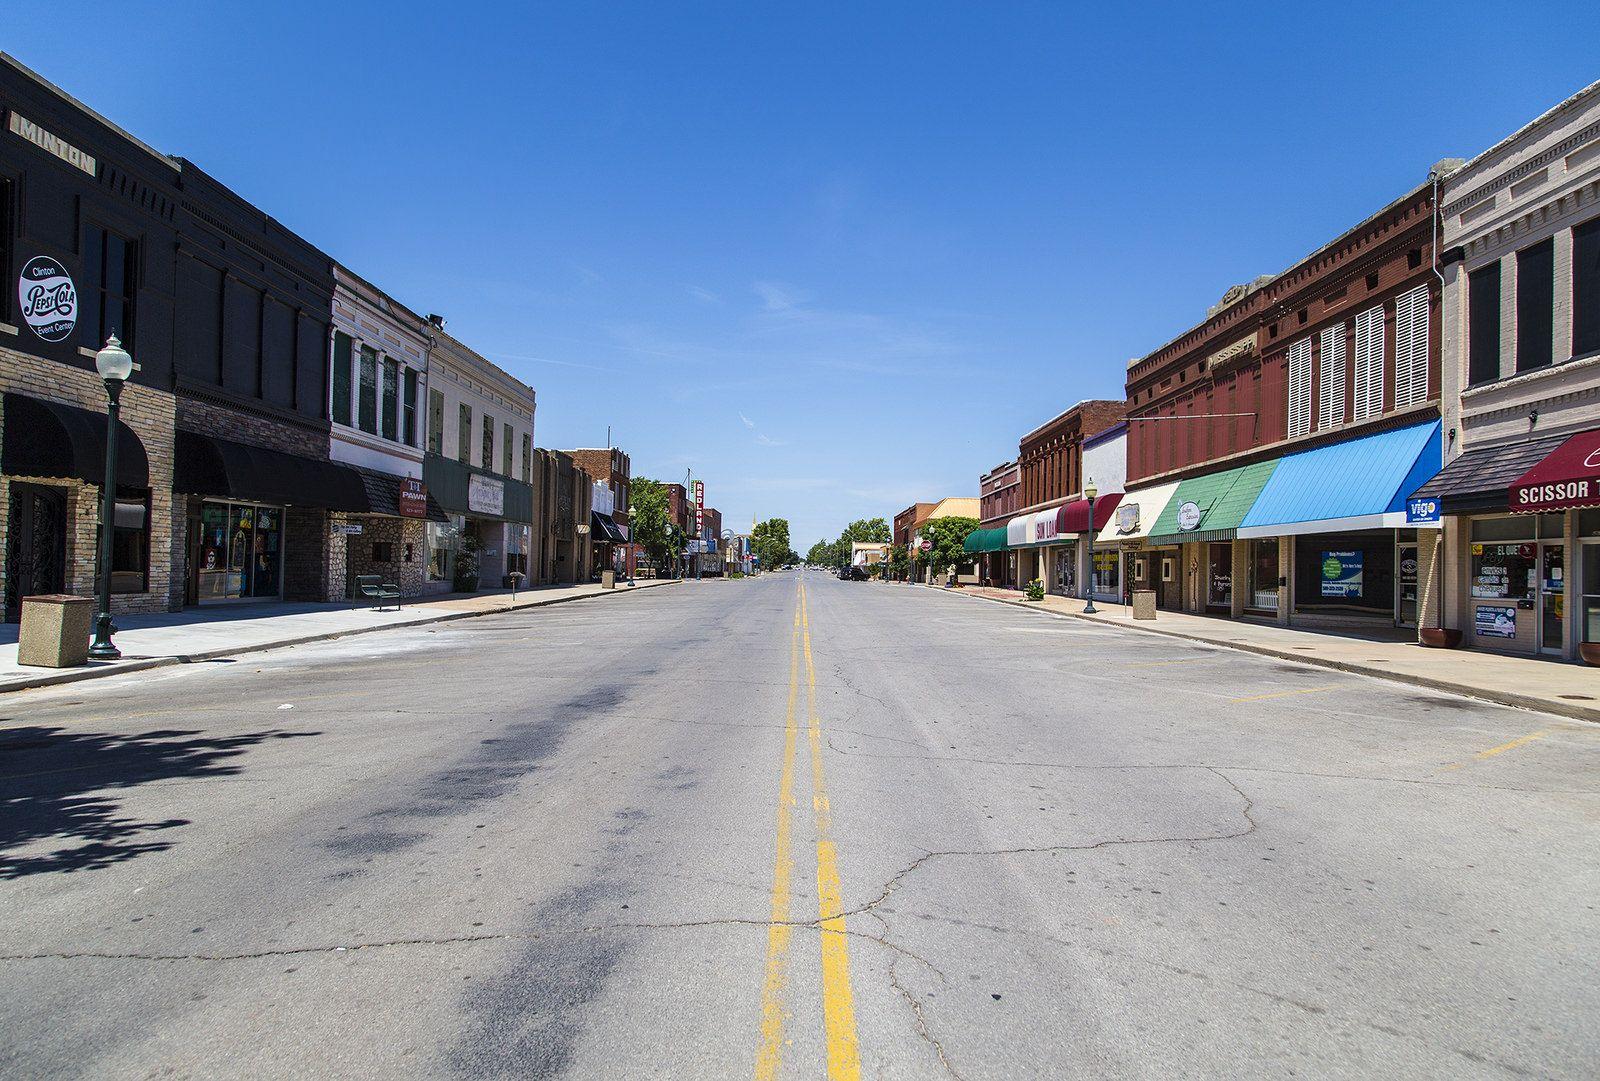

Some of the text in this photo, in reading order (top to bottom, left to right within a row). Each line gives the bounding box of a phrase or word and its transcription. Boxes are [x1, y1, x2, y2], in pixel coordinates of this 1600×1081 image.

[19, 117, 95, 176] MINTON
[33, 267, 55, 277] Clinton
[38, 322, 73, 335] Event Center
[402, 492, 426, 501] PAWN
[1519, 481, 1588, 504] SCISSOR
[1411, 499, 1435, 517] vigo
[1497, 545, 1505, 555] EL
